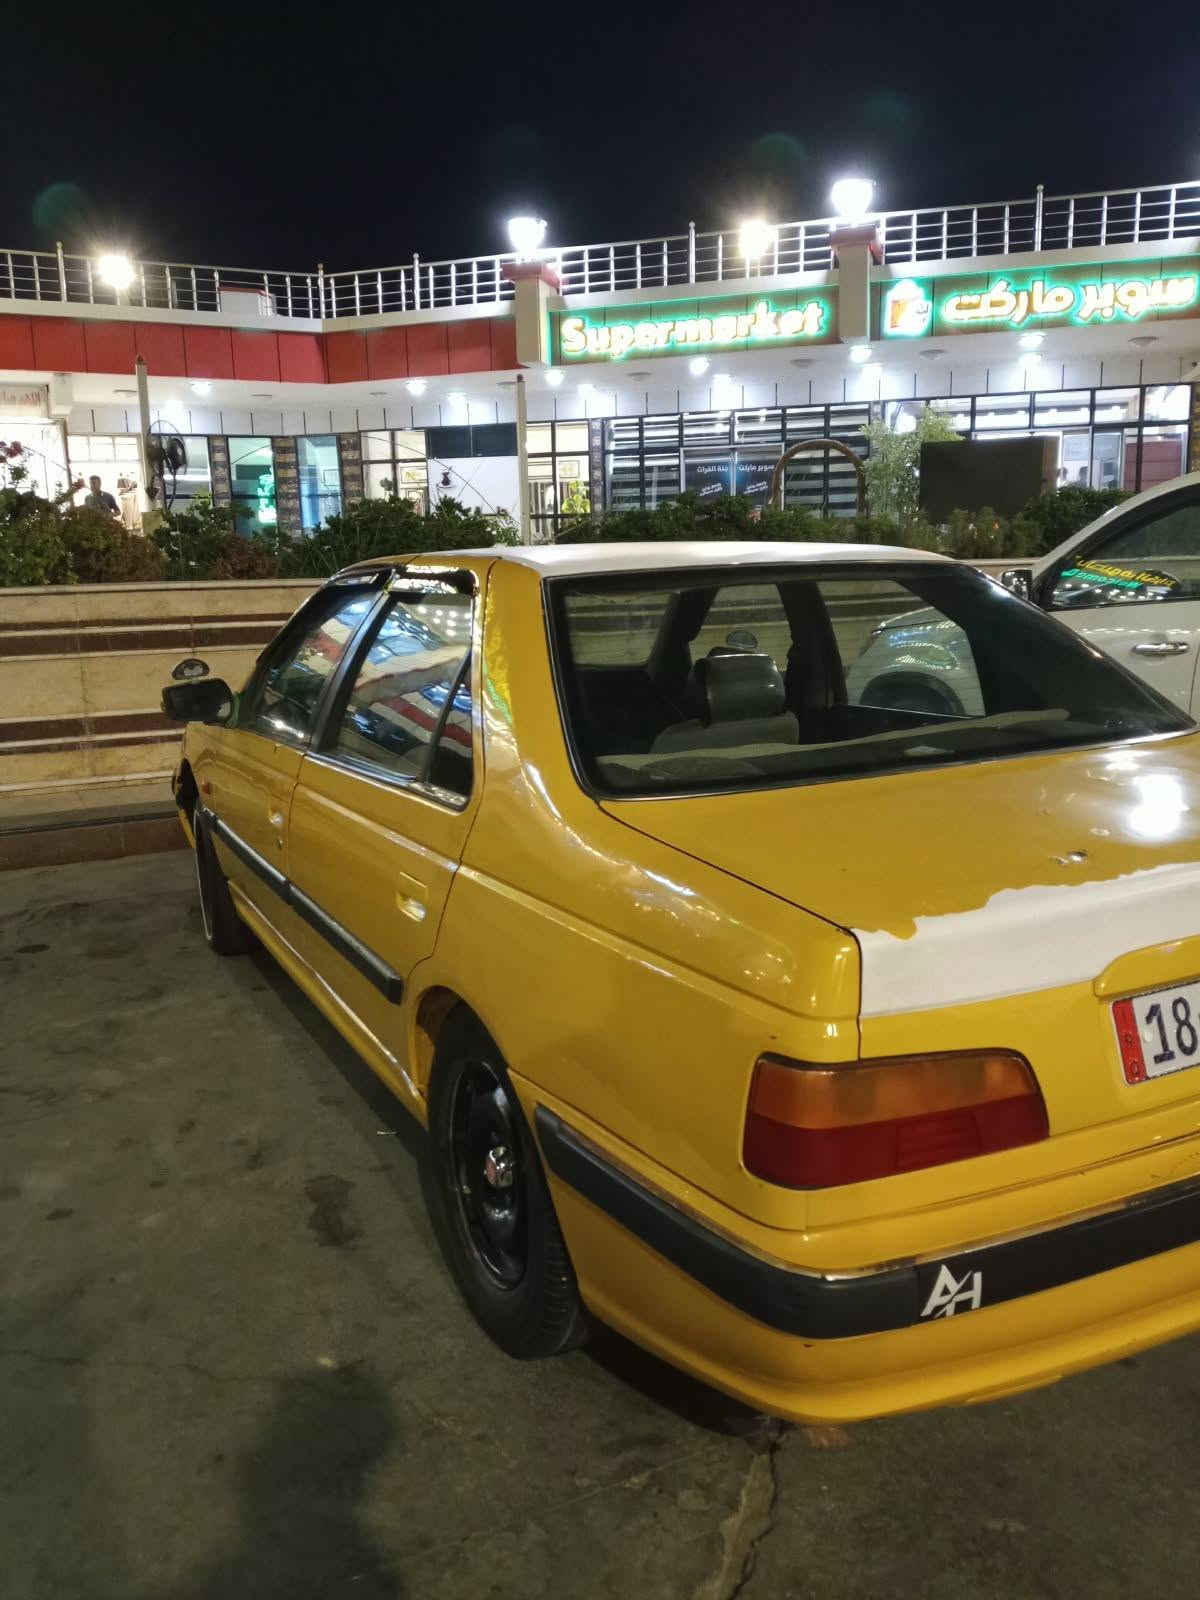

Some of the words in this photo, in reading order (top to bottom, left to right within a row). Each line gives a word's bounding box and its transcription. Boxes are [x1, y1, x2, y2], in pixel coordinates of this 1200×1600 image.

[941, 279, 1074, 323] ماركت
[1077, 275, 1197, 322] سوبر
[560, 299, 824, 358] Supermarket
